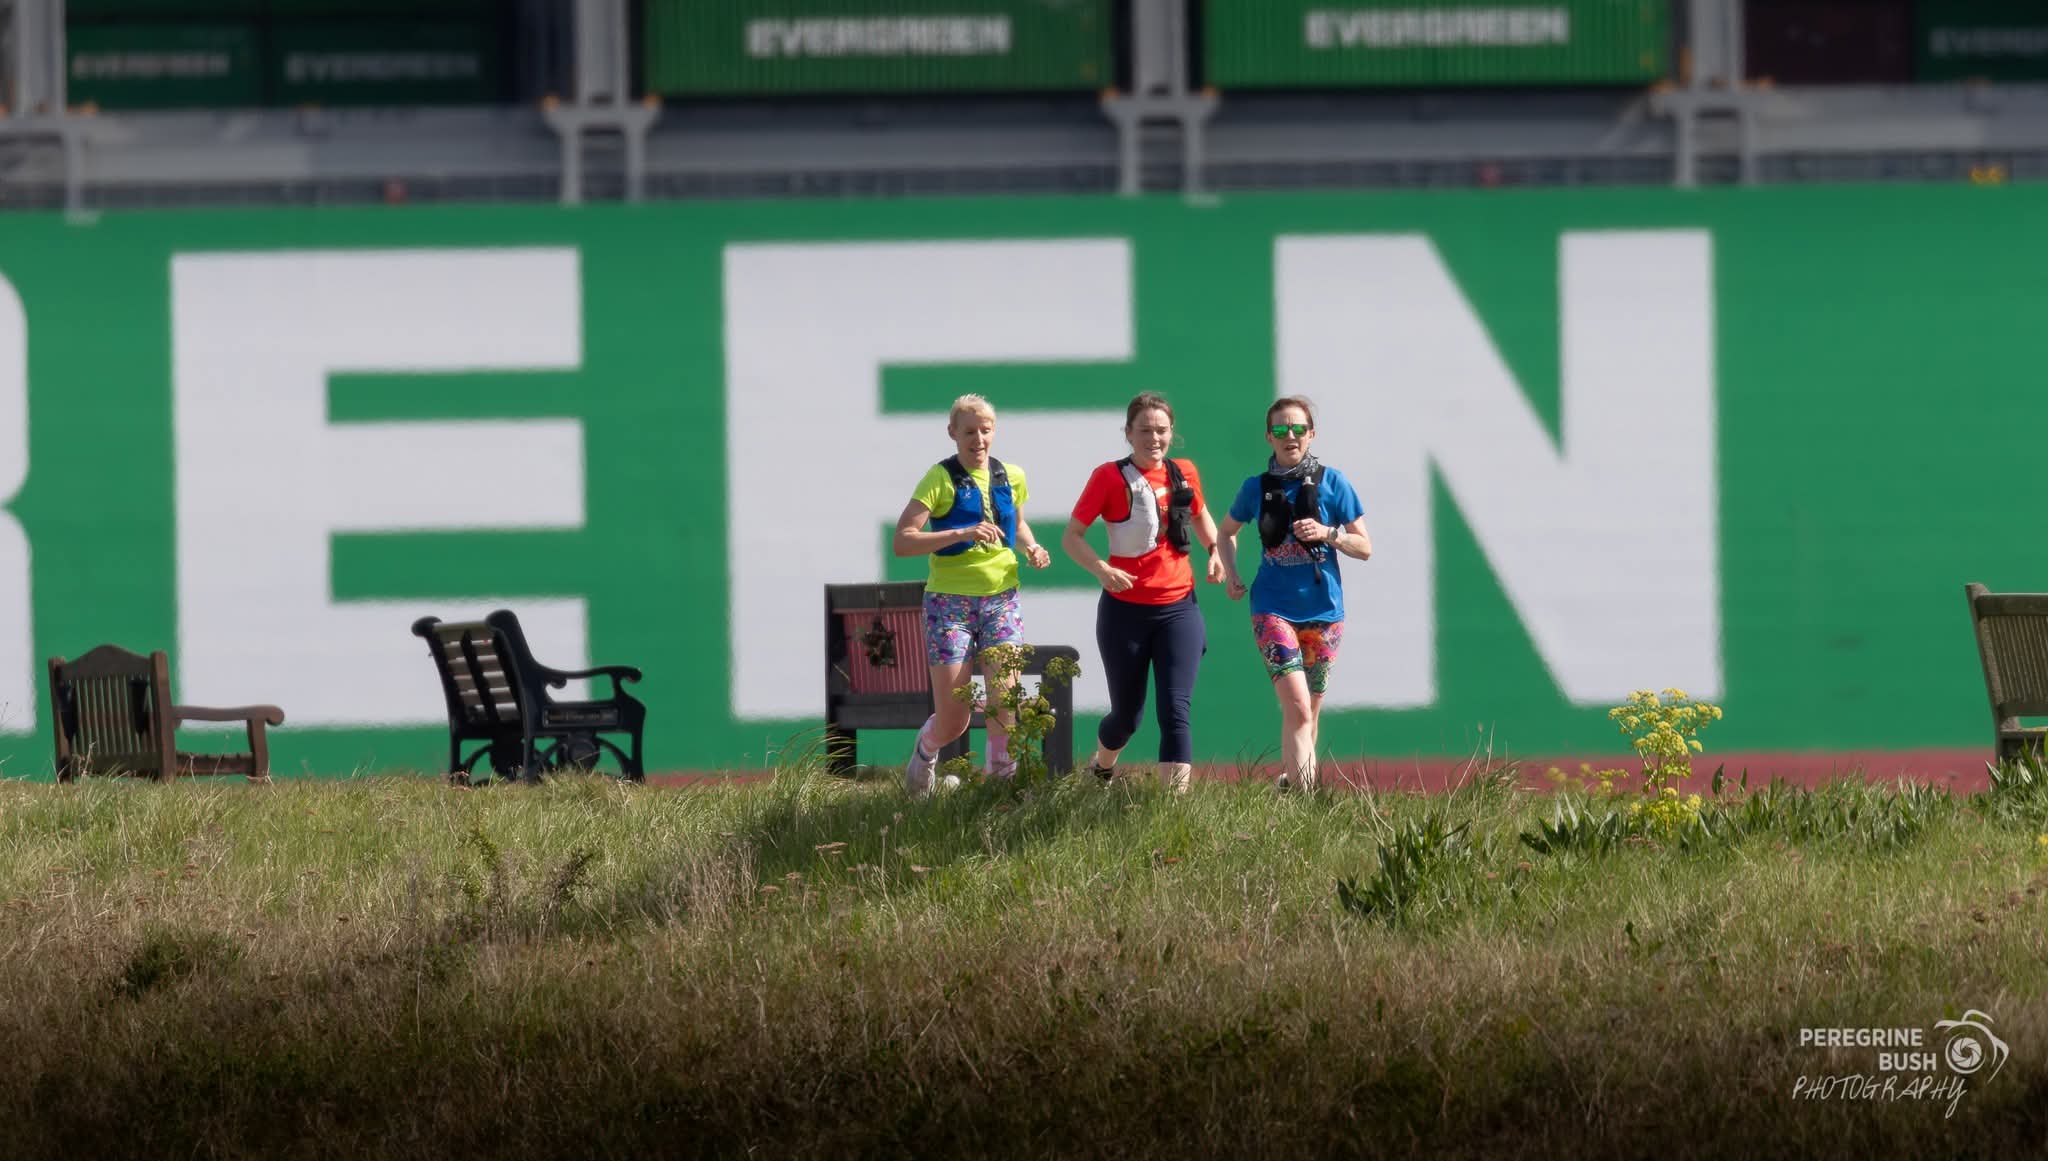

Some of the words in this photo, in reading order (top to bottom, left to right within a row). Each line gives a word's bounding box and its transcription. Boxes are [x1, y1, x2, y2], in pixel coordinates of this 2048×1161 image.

[746, 16, 1011, 55] EVERGREEN
[1306, 8, 1569, 47] EVERGREEN
[0, 229, 1726, 735] EEN
